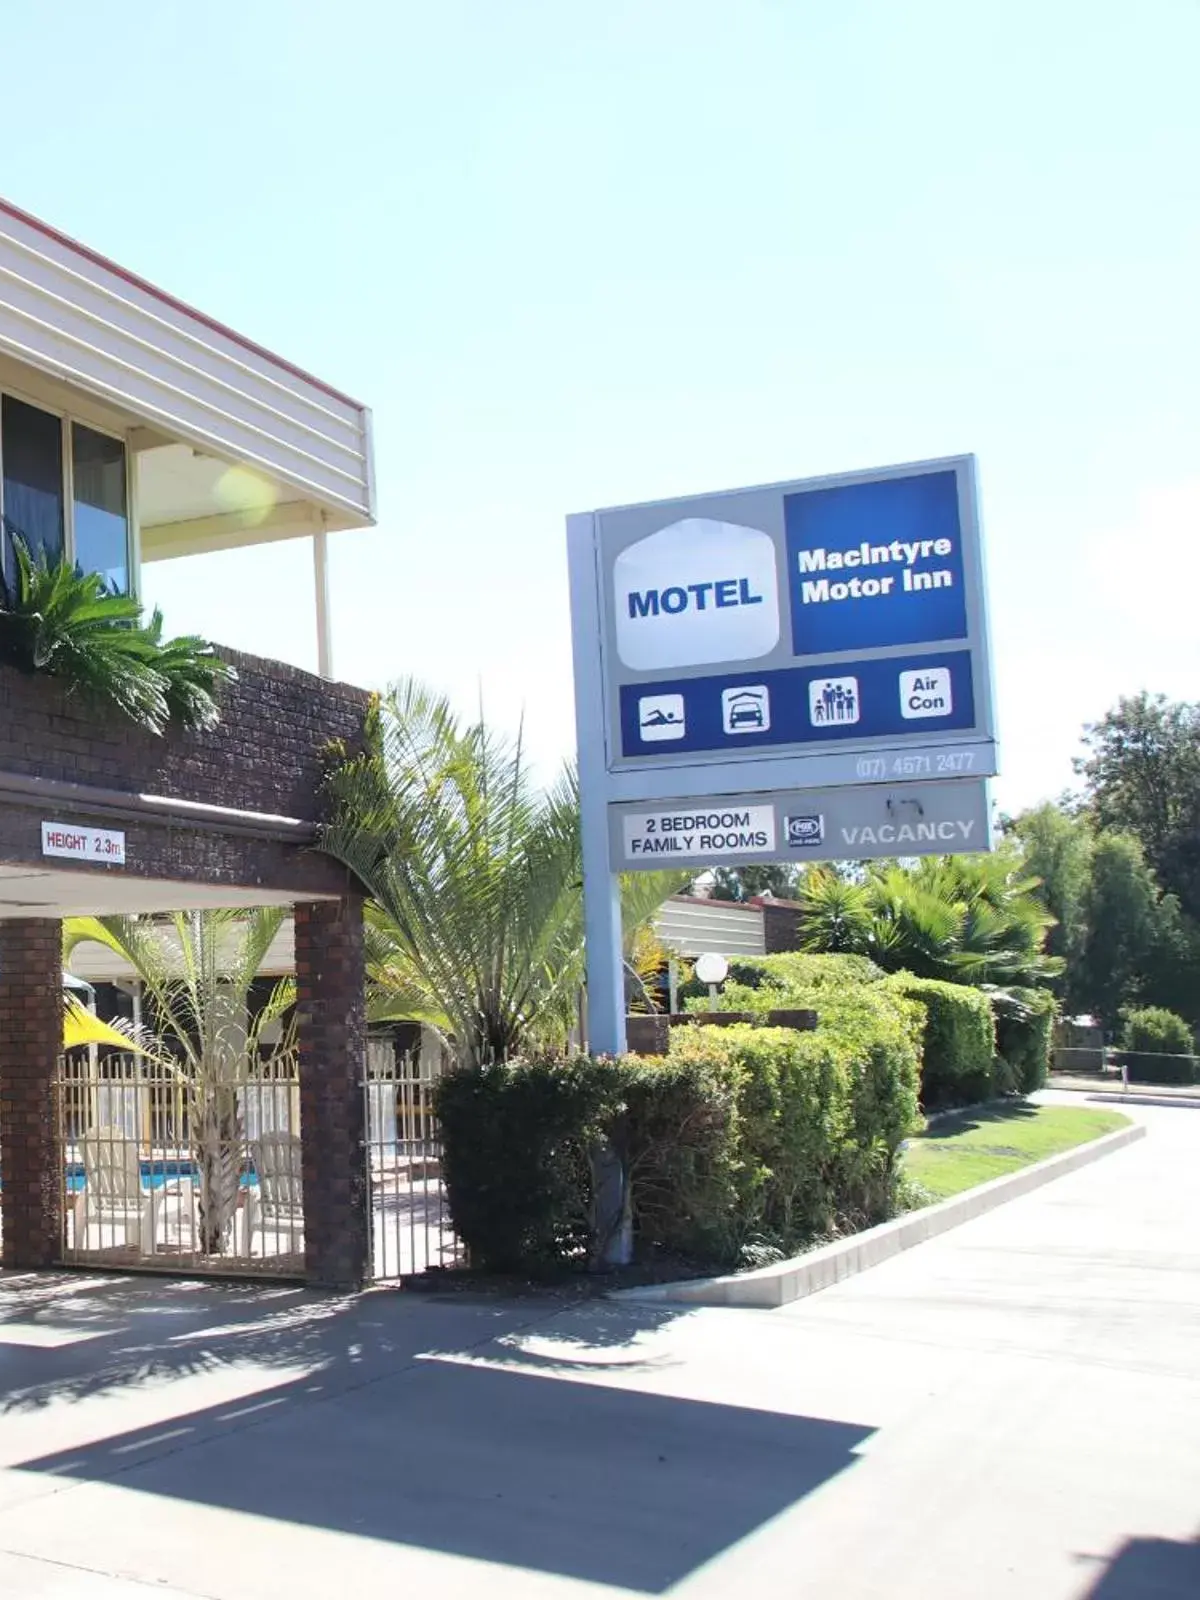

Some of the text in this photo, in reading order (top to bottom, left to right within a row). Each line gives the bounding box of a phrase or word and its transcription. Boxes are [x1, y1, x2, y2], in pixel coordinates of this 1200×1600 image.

[798, 537, 952, 574] MacIntyre
[628, 578, 762, 618] MOTEL
[801, 568, 953, 604] Motor Inn
[912, 676, 938, 692] Air
[908, 694, 945, 711] Con
[856, 758, 886, 778] (07)
[936, 752, 975, 771] 2477
[646, 813, 750, 833] 2 BEDROOM
[841, 820, 975, 846] VACANCY
[47, 832, 87, 851] HEIGHT
[631, 835, 693, 854] FAMILY
[699, 831, 768, 850] ROOMS
